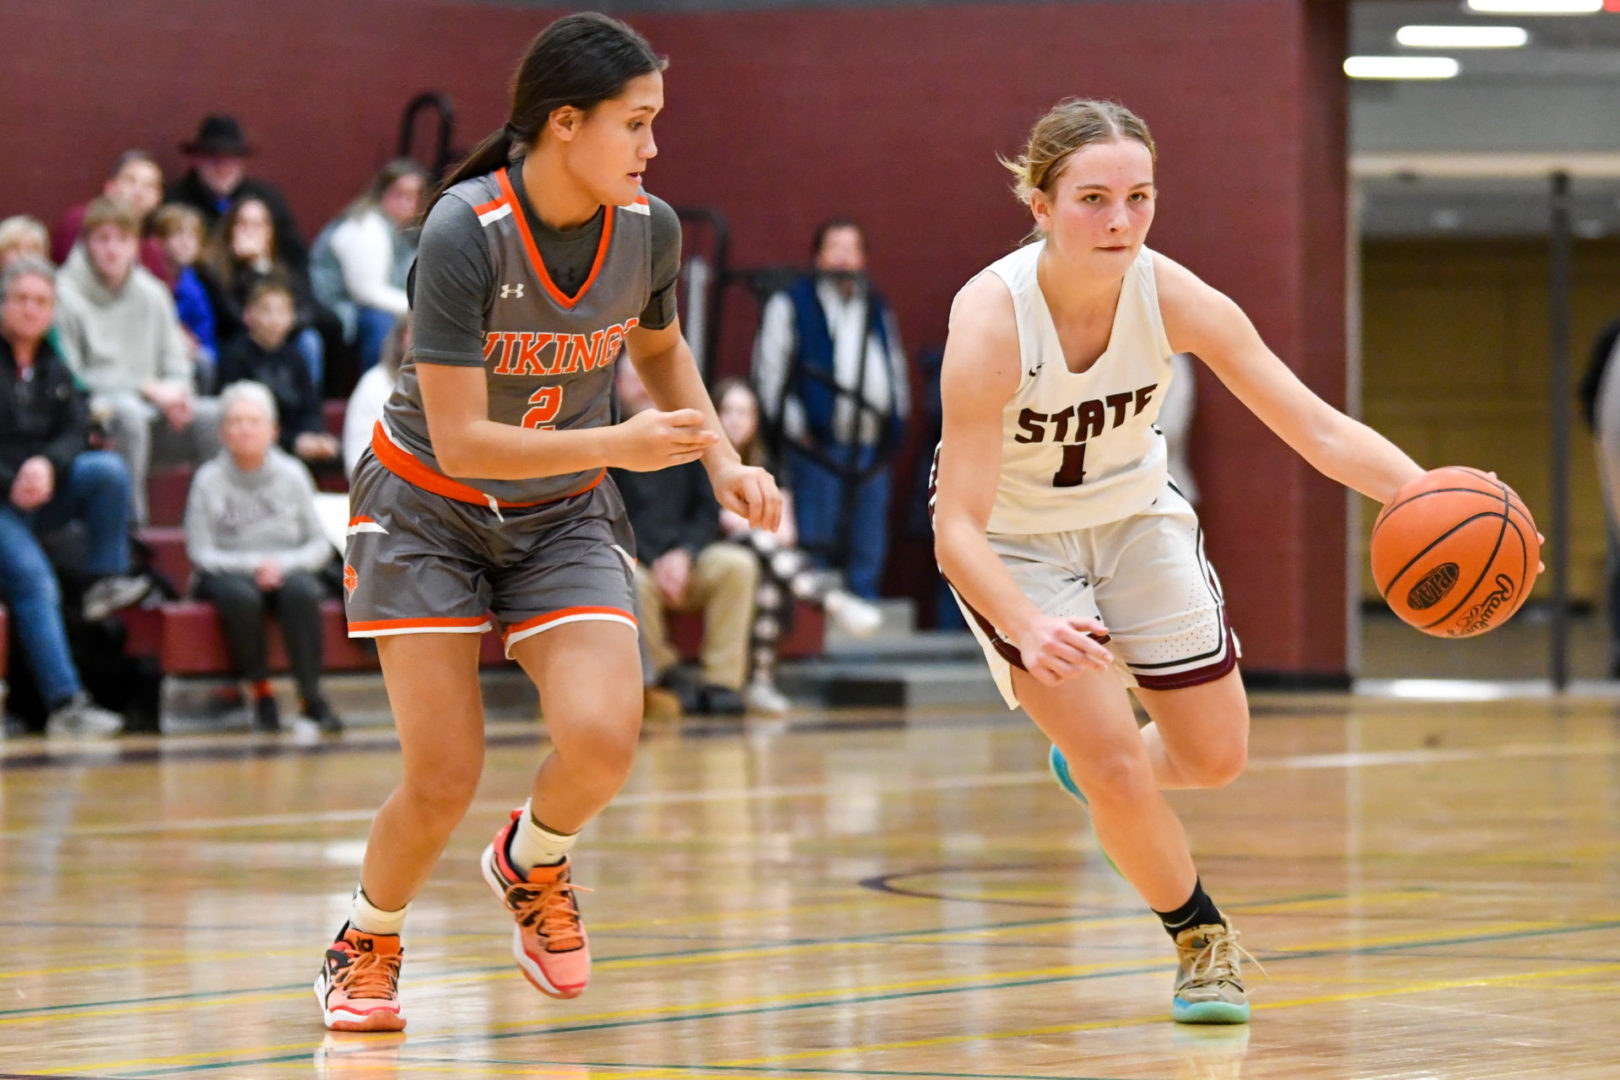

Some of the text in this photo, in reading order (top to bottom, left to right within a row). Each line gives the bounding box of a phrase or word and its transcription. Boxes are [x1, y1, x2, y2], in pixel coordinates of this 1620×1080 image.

[482, 316, 639, 376] VIKING
[521, 385, 563, 431] 2
[1052, 443, 1087, 487] 1
